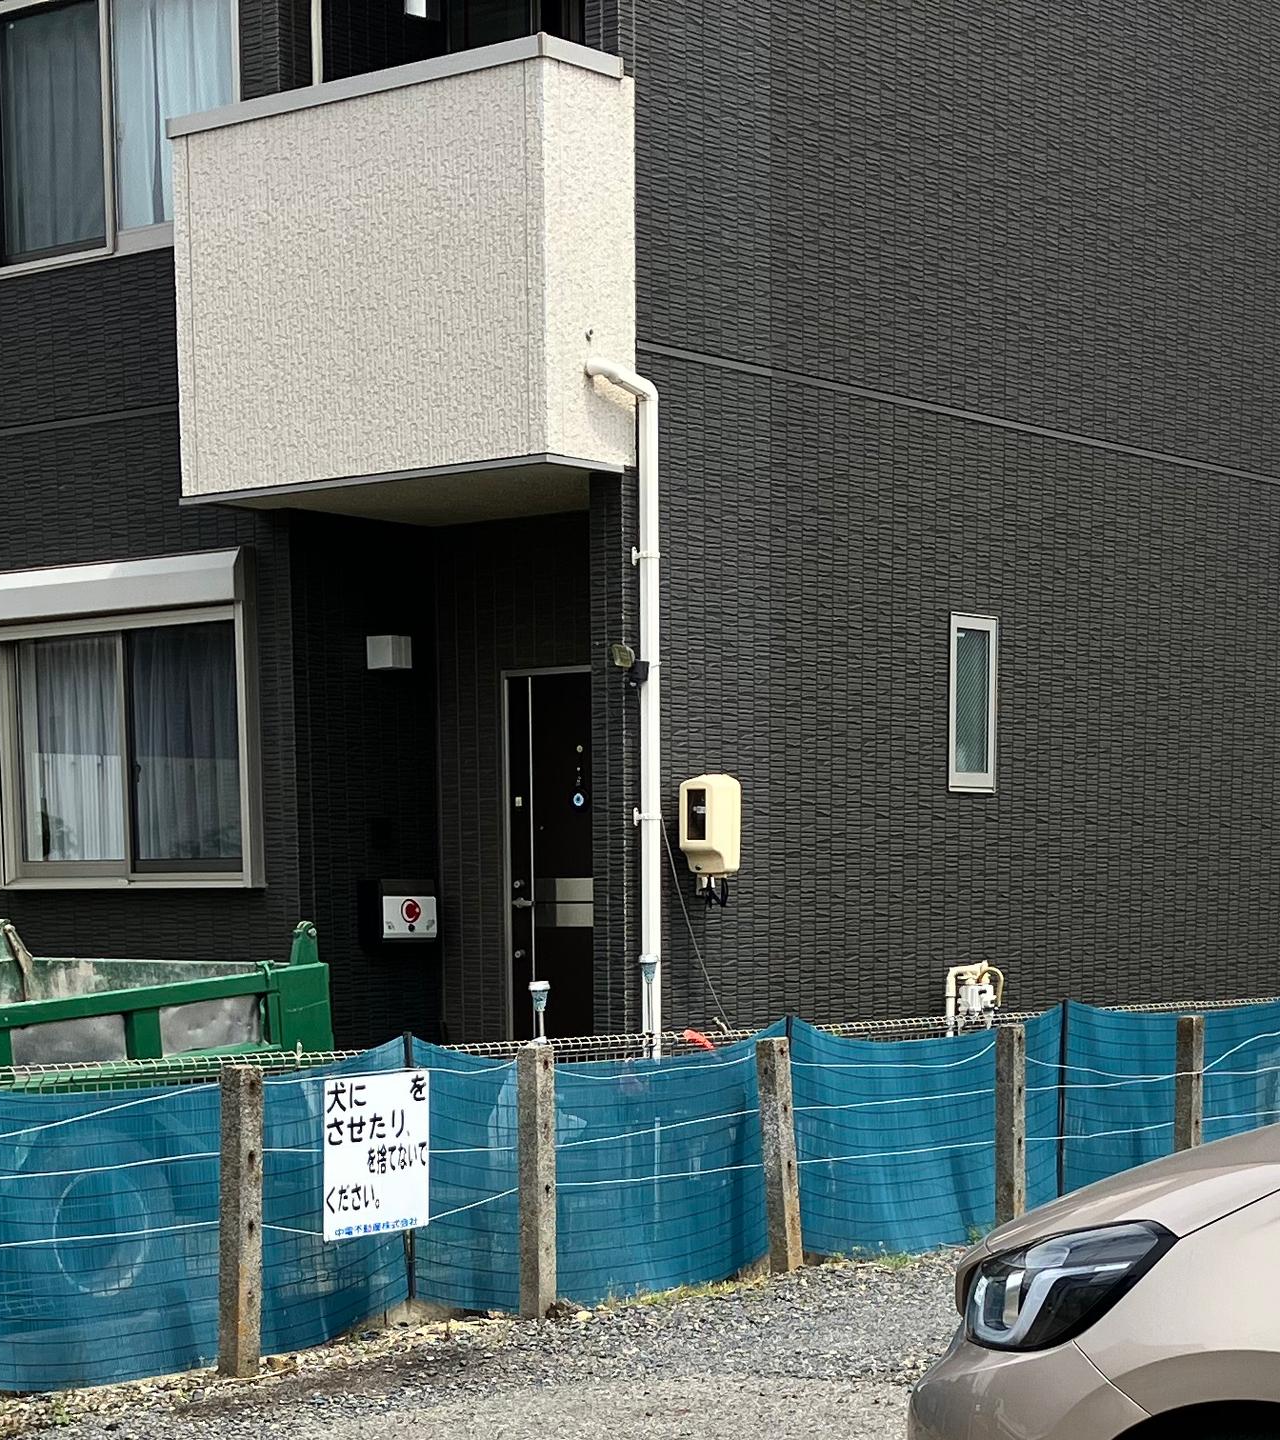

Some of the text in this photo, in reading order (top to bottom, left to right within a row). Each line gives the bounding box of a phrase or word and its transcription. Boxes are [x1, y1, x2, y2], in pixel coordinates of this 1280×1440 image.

[326, 1074, 426, 1113] 犬に を
[326, 1183, 380, 1213] ください。
